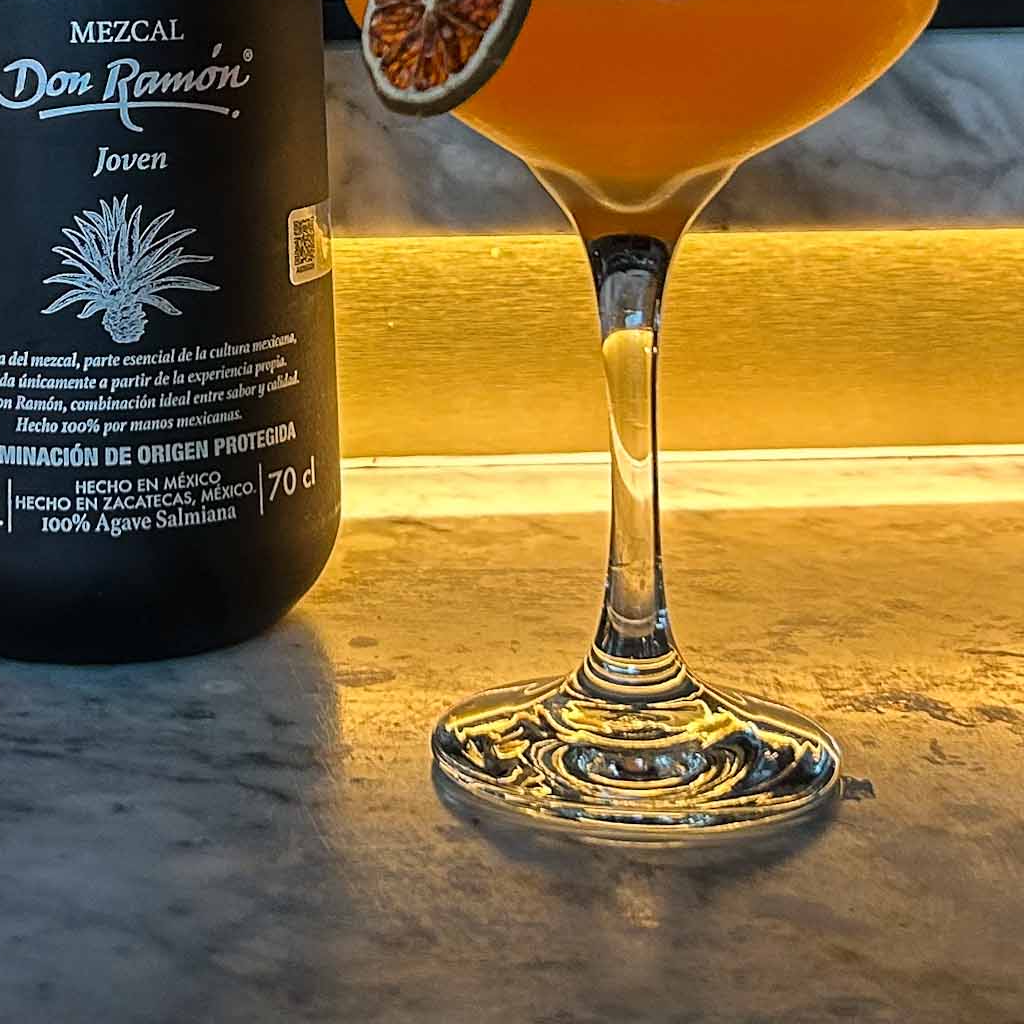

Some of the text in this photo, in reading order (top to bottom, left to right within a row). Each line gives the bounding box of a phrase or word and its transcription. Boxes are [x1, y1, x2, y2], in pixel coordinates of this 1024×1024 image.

[70, 19, 184, 44] MEZCAL
[102, 43, 250, 132] Ramón
[93, 147, 168, 177] Joven
[8, 351, 28, 366] del
[30, 352, 81, 369] mezcal,
[83, 353, 120, 372] parte
[122, 349, 175, 366] esencial
[177, 347, 193, 363] de
[195, 346, 207, 360] la
[209, 342, 251, 359] cultura
[18, 373, 97, 390] únicamente
[99, 378, 108, 389] a
[110, 373, 153, 393] partir
[154, 370, 170, 386] de
[173, 370, 185, 385] la
[188, 361, 253, 386] experiencia
[15, 395, 68, 414] Ramón,
[70, 394, 156, 412] combinación
[159, 390, 190, 408] ideal
[194, 390, 224, 405] entre
[226, 382, 257, 400] sabor
[257, 383, 265, 398] y
[15, 408, 243, 437] Hecho 100% por manos mexicanas.
[104, 446, 132, 466] DE
[137, 439, 209, 465] ORIGEN
[214, 421, 297, 457] PROTEGIDA
[76, 471, 222, 495] HECHO EN MÉXICO
[268, 455, 316, 502] 70 cl
[15, 481, 257, 512] HECHO EN ZACATECAS, MÉXICO.
[41, 504, 237, 537] 100% Agave Salmiana
